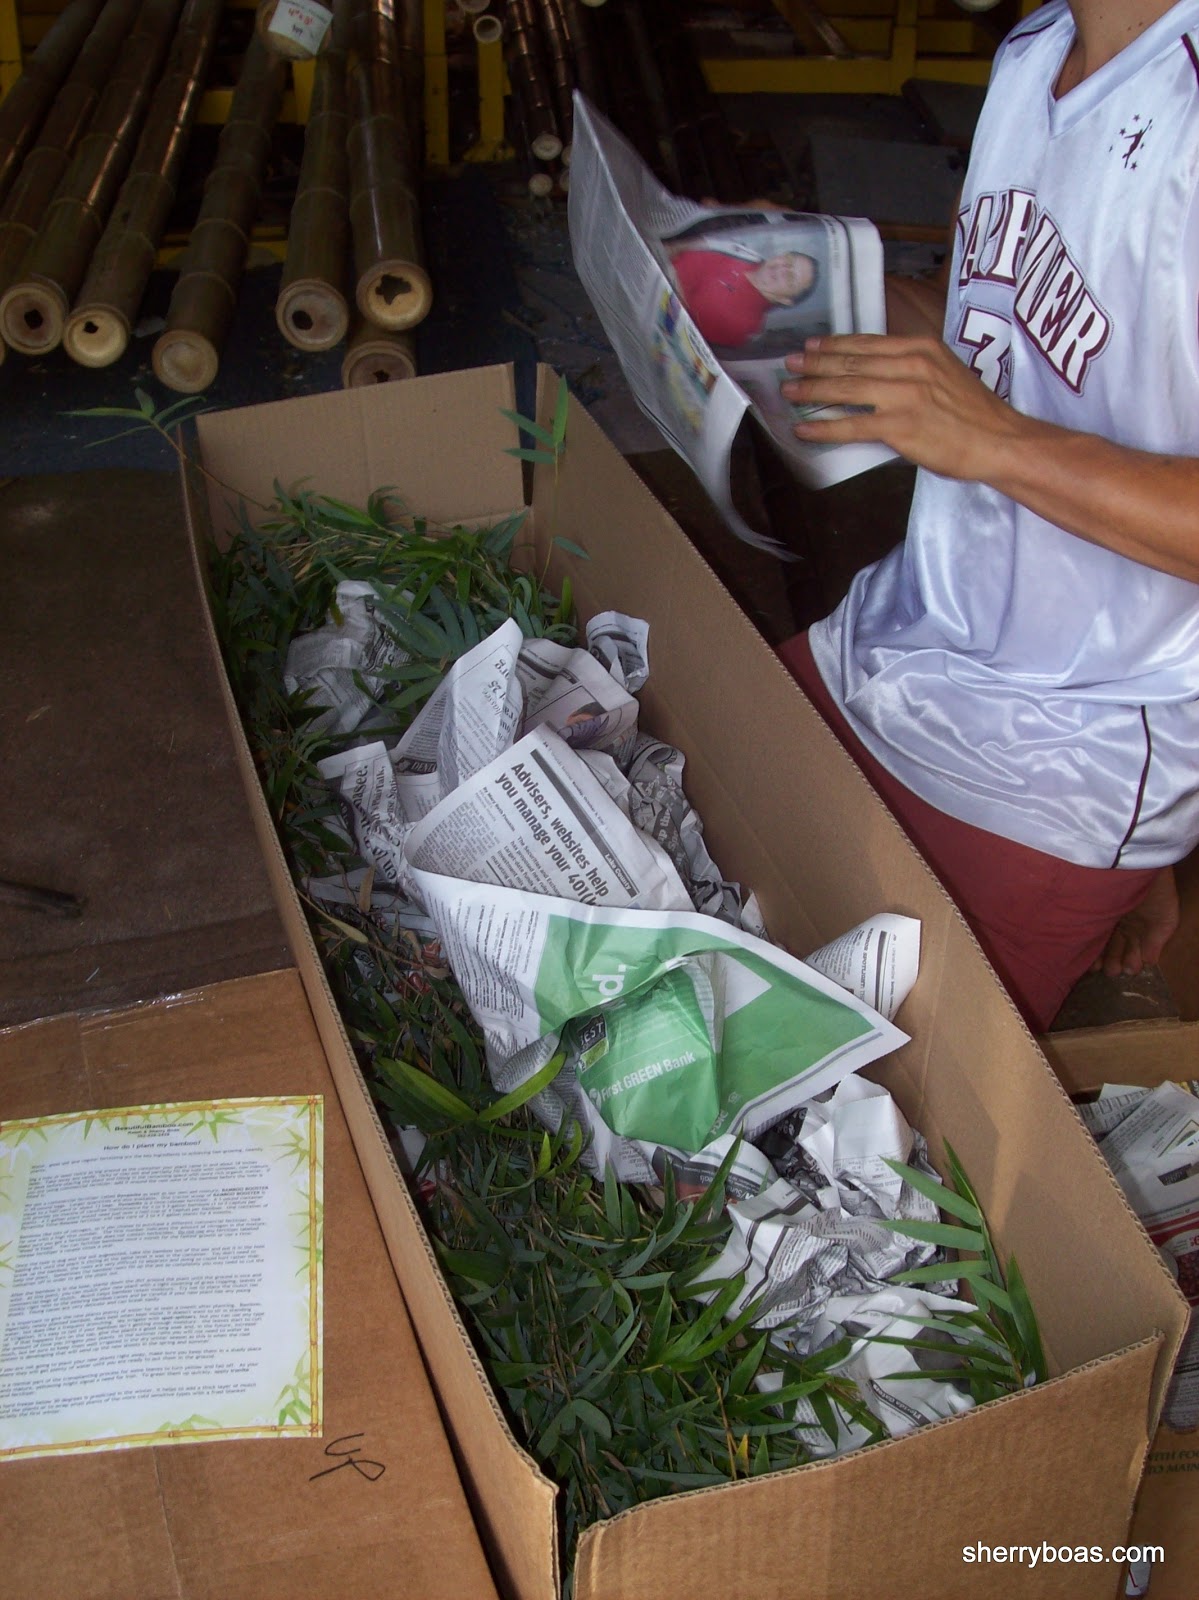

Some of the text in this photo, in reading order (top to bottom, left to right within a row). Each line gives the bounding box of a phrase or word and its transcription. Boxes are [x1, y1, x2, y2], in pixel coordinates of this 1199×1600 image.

[493, 772, 519, 800] you
[511, 796, 553, 847] manage
[544, 843, 572, 875] your
[508, 760, 612, 900] Advisers, websites help
[489, 854, 510, 880] marketing
[496, 849, 524, 886] investment mix
[502, 845, 534, 886] target-date funds
[509, 840, 519, 850] has
[515, 849, 534, 873] proposed
[531, 871, 540, 882] new
[516, 835, 526, 846] The
[523, 845, 542, 869] Securities
[539, 868, 549, 879] and
[603, 852, 632, 891] Lake County
[601, 1051, 696, 1101] First GREEN Bank
[103, 1143, 122, 1151] How
[136, 1141, 155, 1151] plant
[156, 1141, 168, 1150] my
